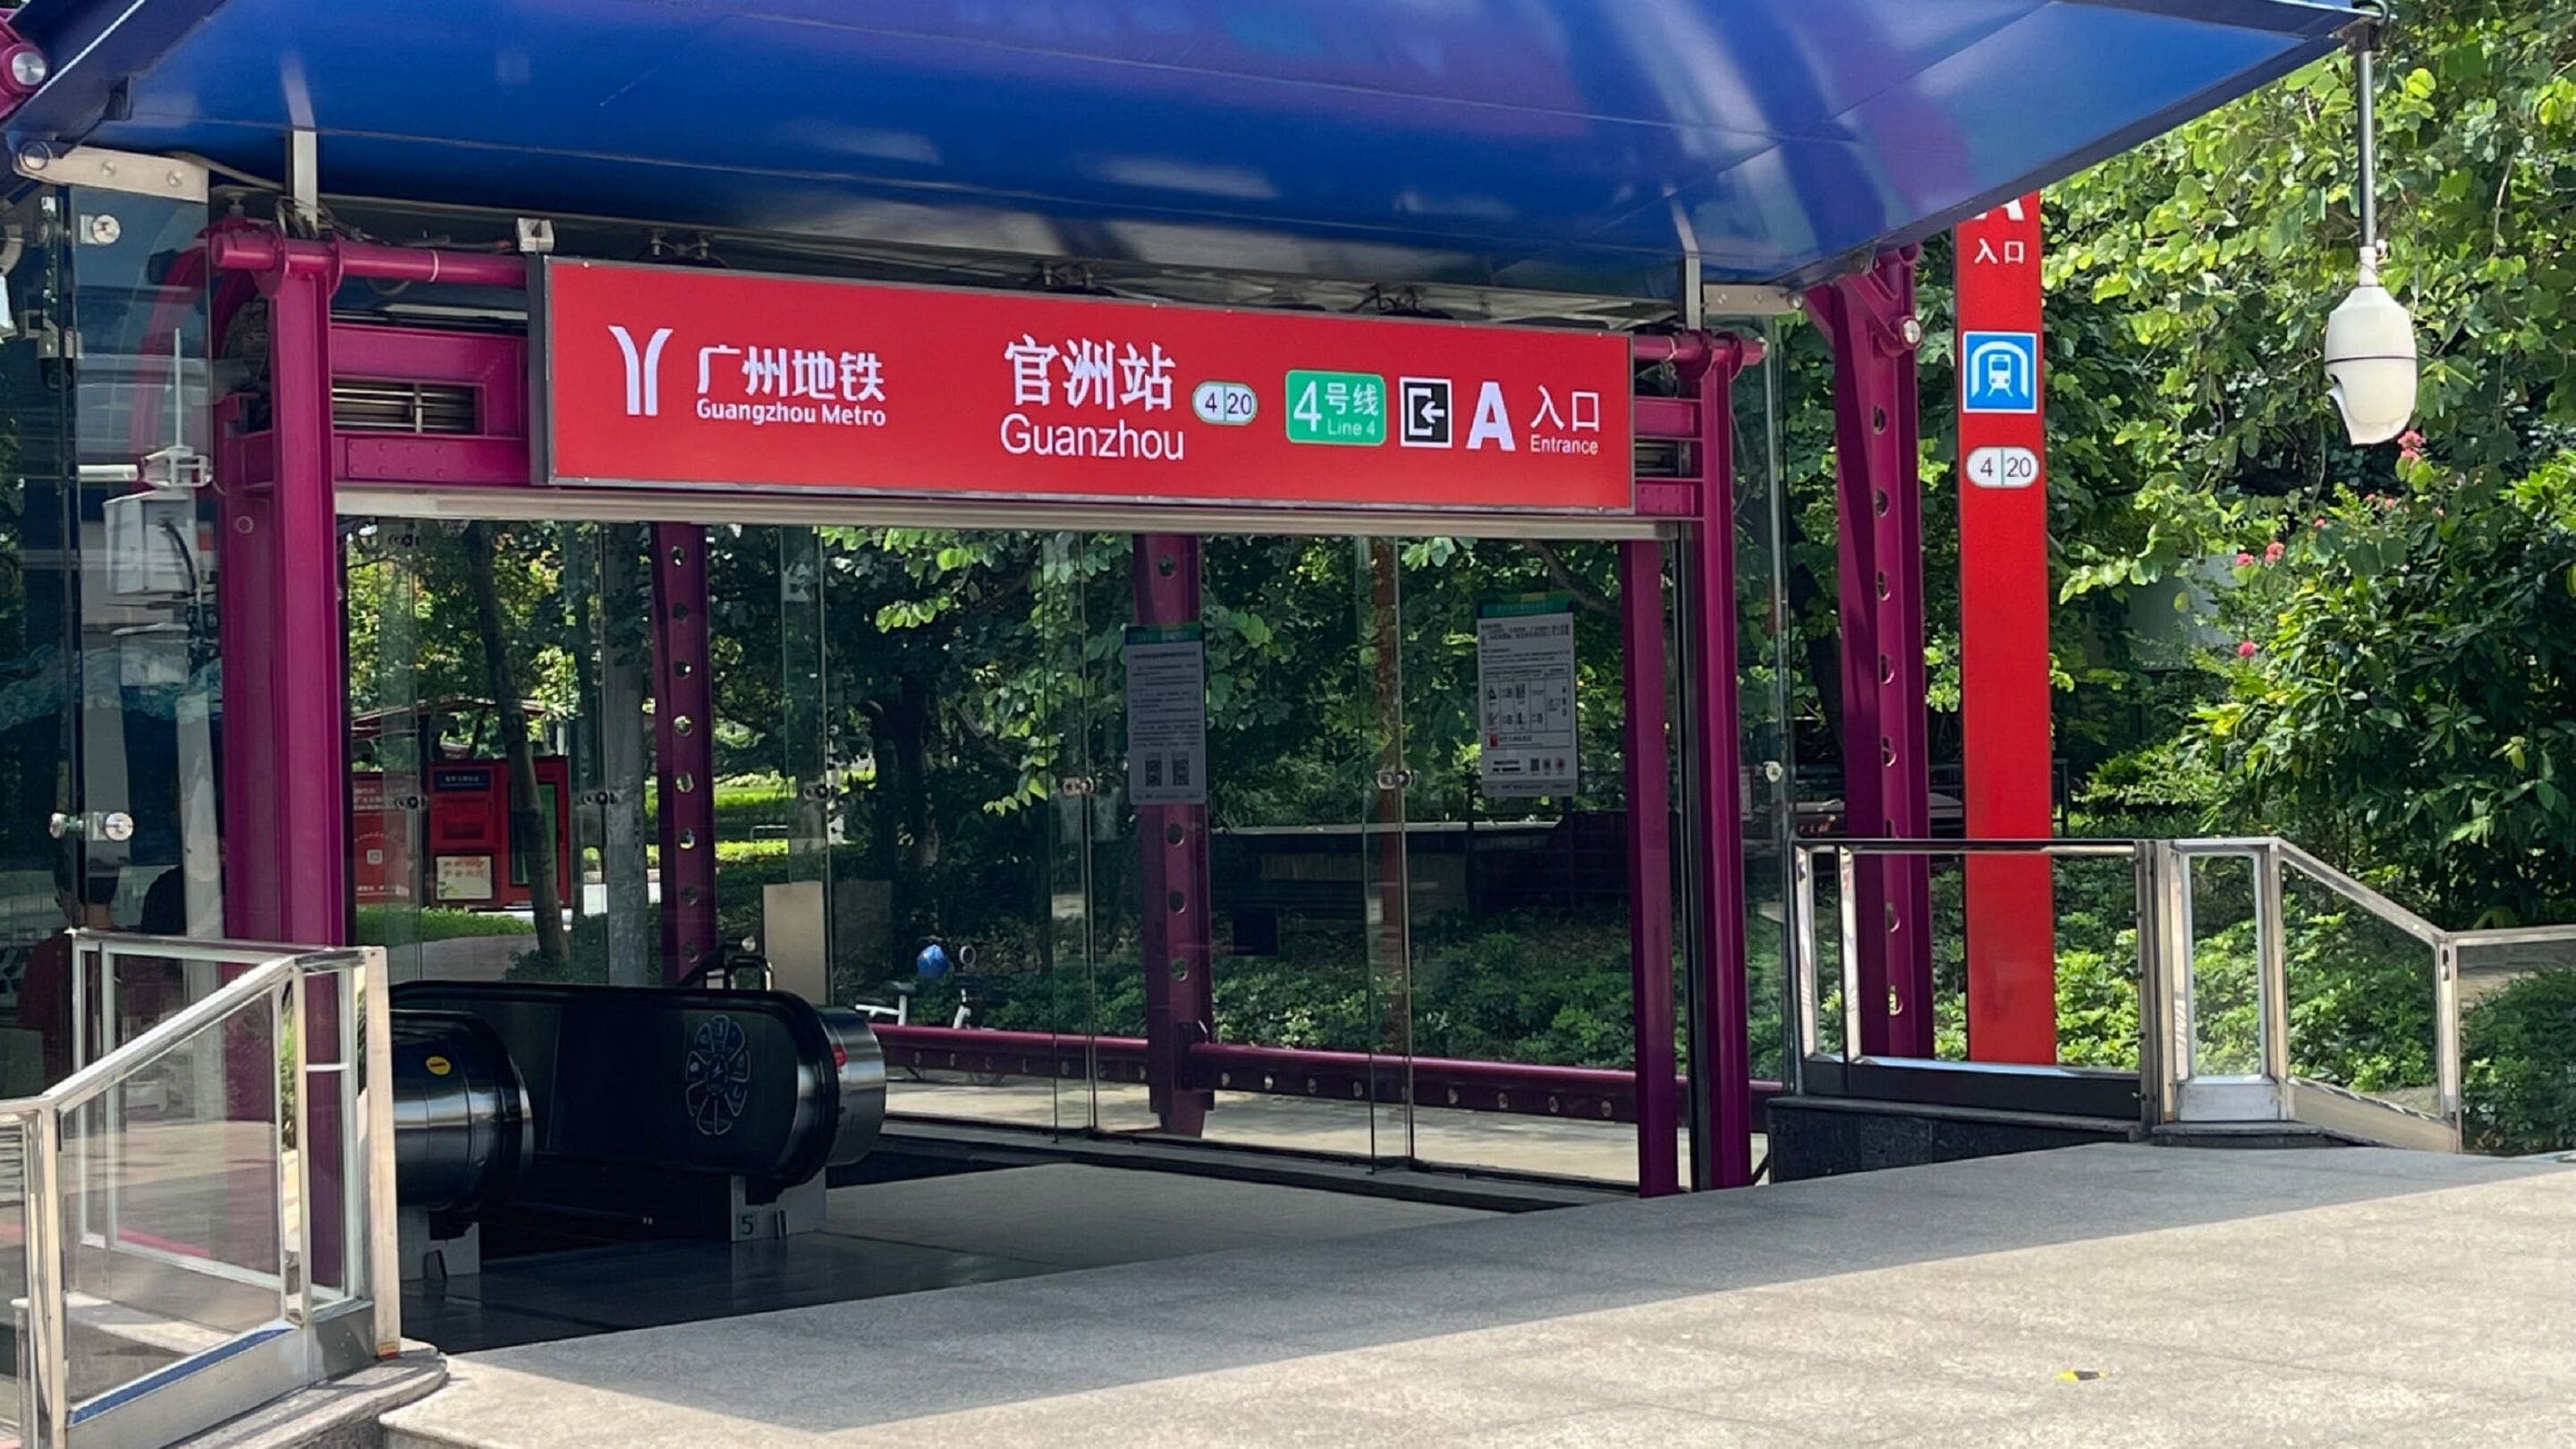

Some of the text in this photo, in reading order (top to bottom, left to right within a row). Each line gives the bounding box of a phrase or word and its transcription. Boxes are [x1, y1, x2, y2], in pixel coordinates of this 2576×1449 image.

[1974, 237, 2025, 265] 入口
[697, 344, 886, 402] 广州地铁
[1004, 333, 1177, 411] 官洲站
[697, 398, 886, 427] Guangzhou Metro
[1204, 392, 1253, 416] 4 20
[1466, 381, 1516, 452] A
[1530, 385, 1600, 432] 入口
[1000, 413, 1184, 462] Guanzhou
[1326, 418, 1377, 437] Line 4
[1530, 434, 1599, 456] Entrance
[1979, 457, 2032, 478] 4 20
[741, 1214, 754, 1236] 5
